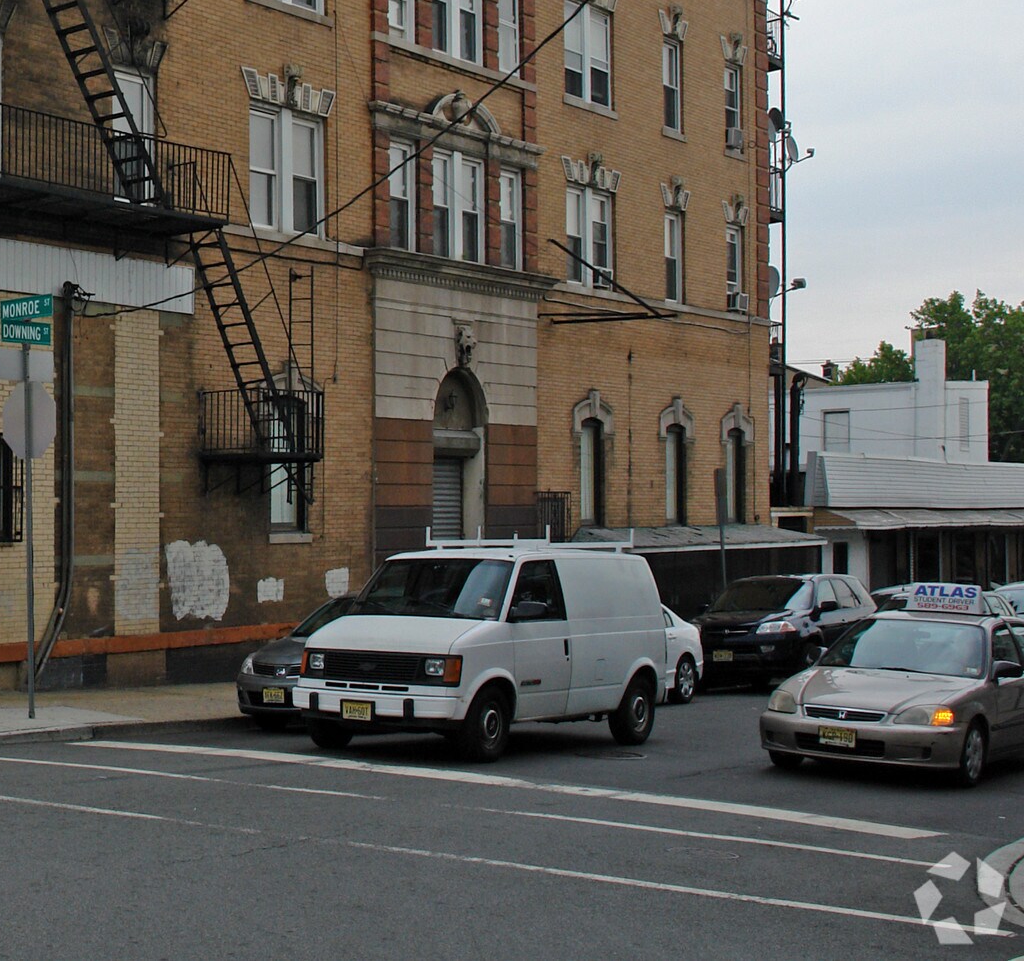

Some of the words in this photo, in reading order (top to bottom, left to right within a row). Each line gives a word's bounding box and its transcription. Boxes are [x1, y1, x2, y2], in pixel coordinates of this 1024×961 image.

[2, 299, 41, 319] MONROE
[43, 297, 51, 307] ST
[2, 323, 42, 341] DOWNING
[43, 327, 50, 335] ST
[913, 584, 978, 599] ATLAS
[913, 596, 946, 604] STUDENT
